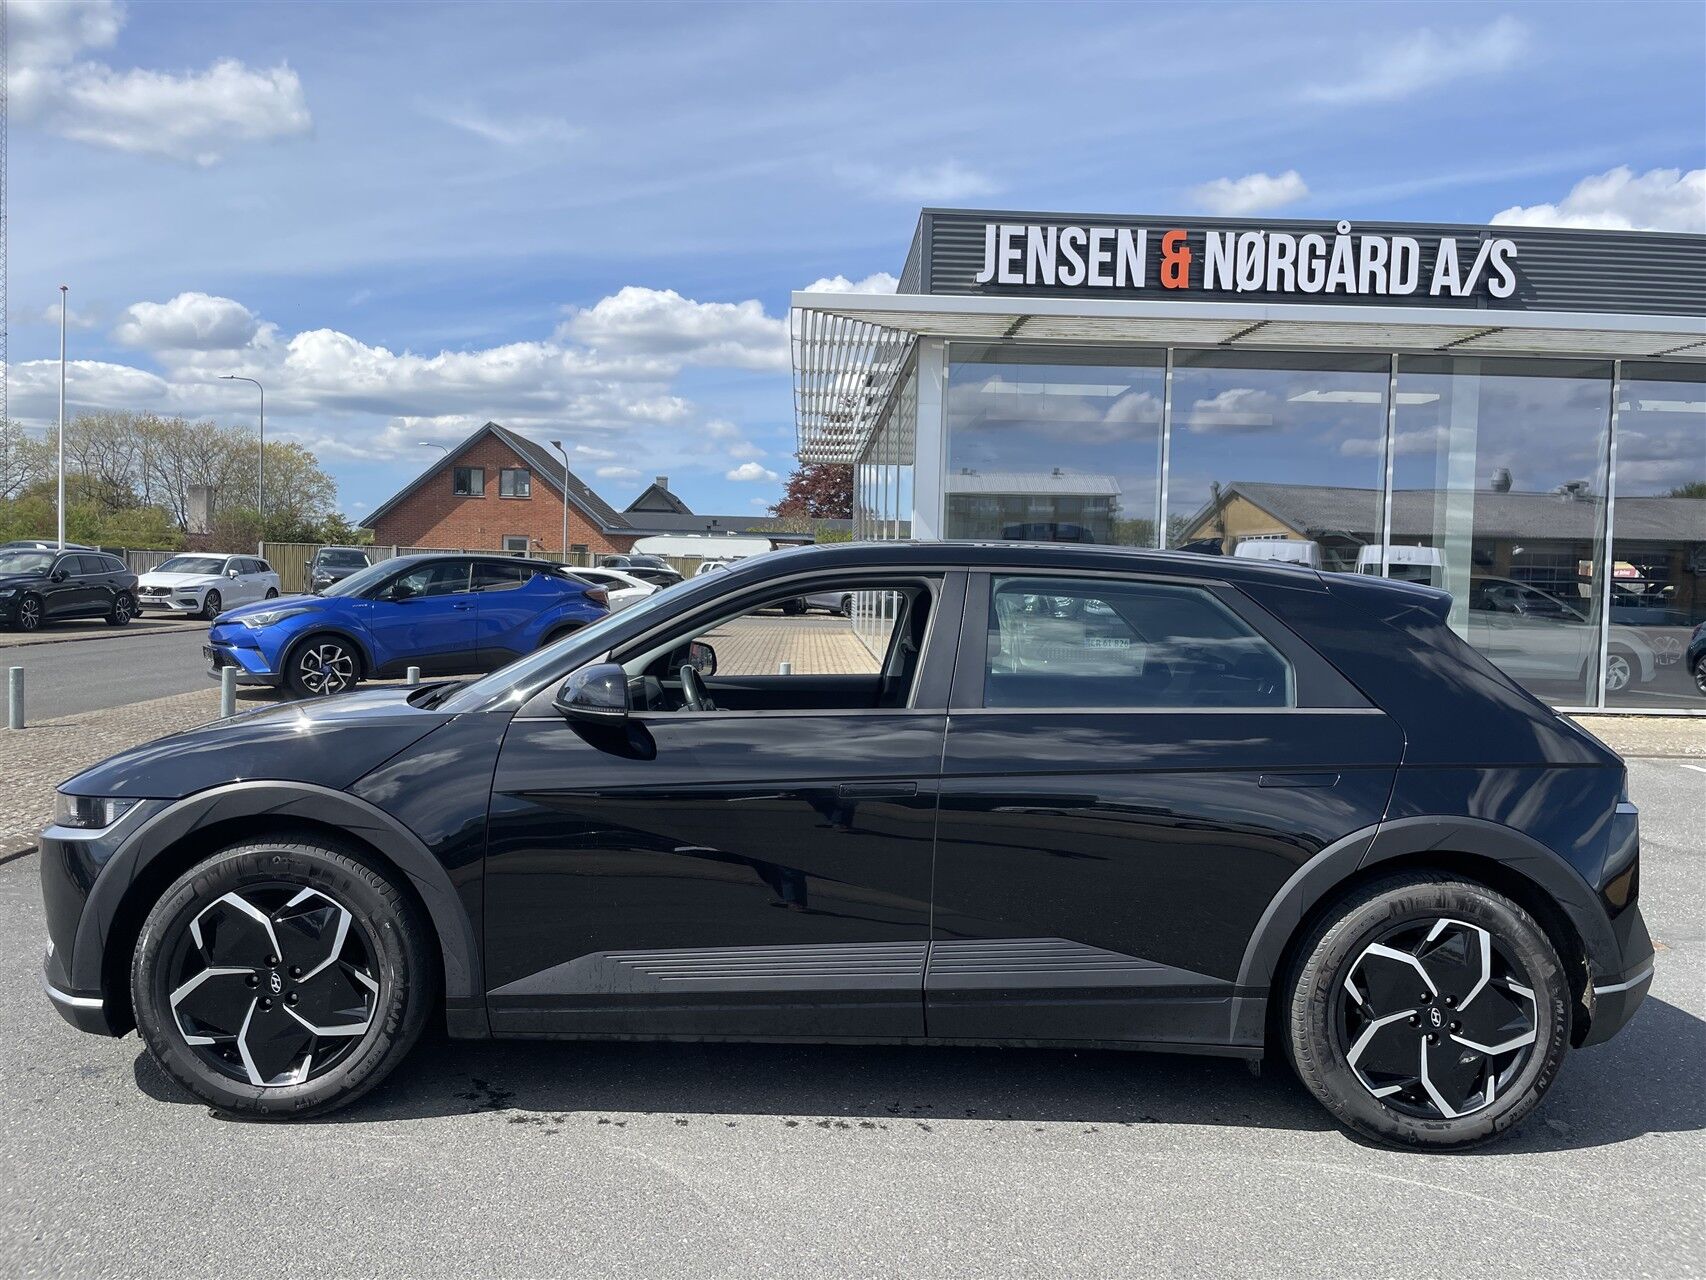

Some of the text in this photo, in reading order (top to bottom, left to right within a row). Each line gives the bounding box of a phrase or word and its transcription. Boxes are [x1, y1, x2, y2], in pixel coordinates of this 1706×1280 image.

[976, 219, 1518, 298] JENSEN & NØRGÅRD A/S
[1538, 999, 1565, 1089] MICHLIN
